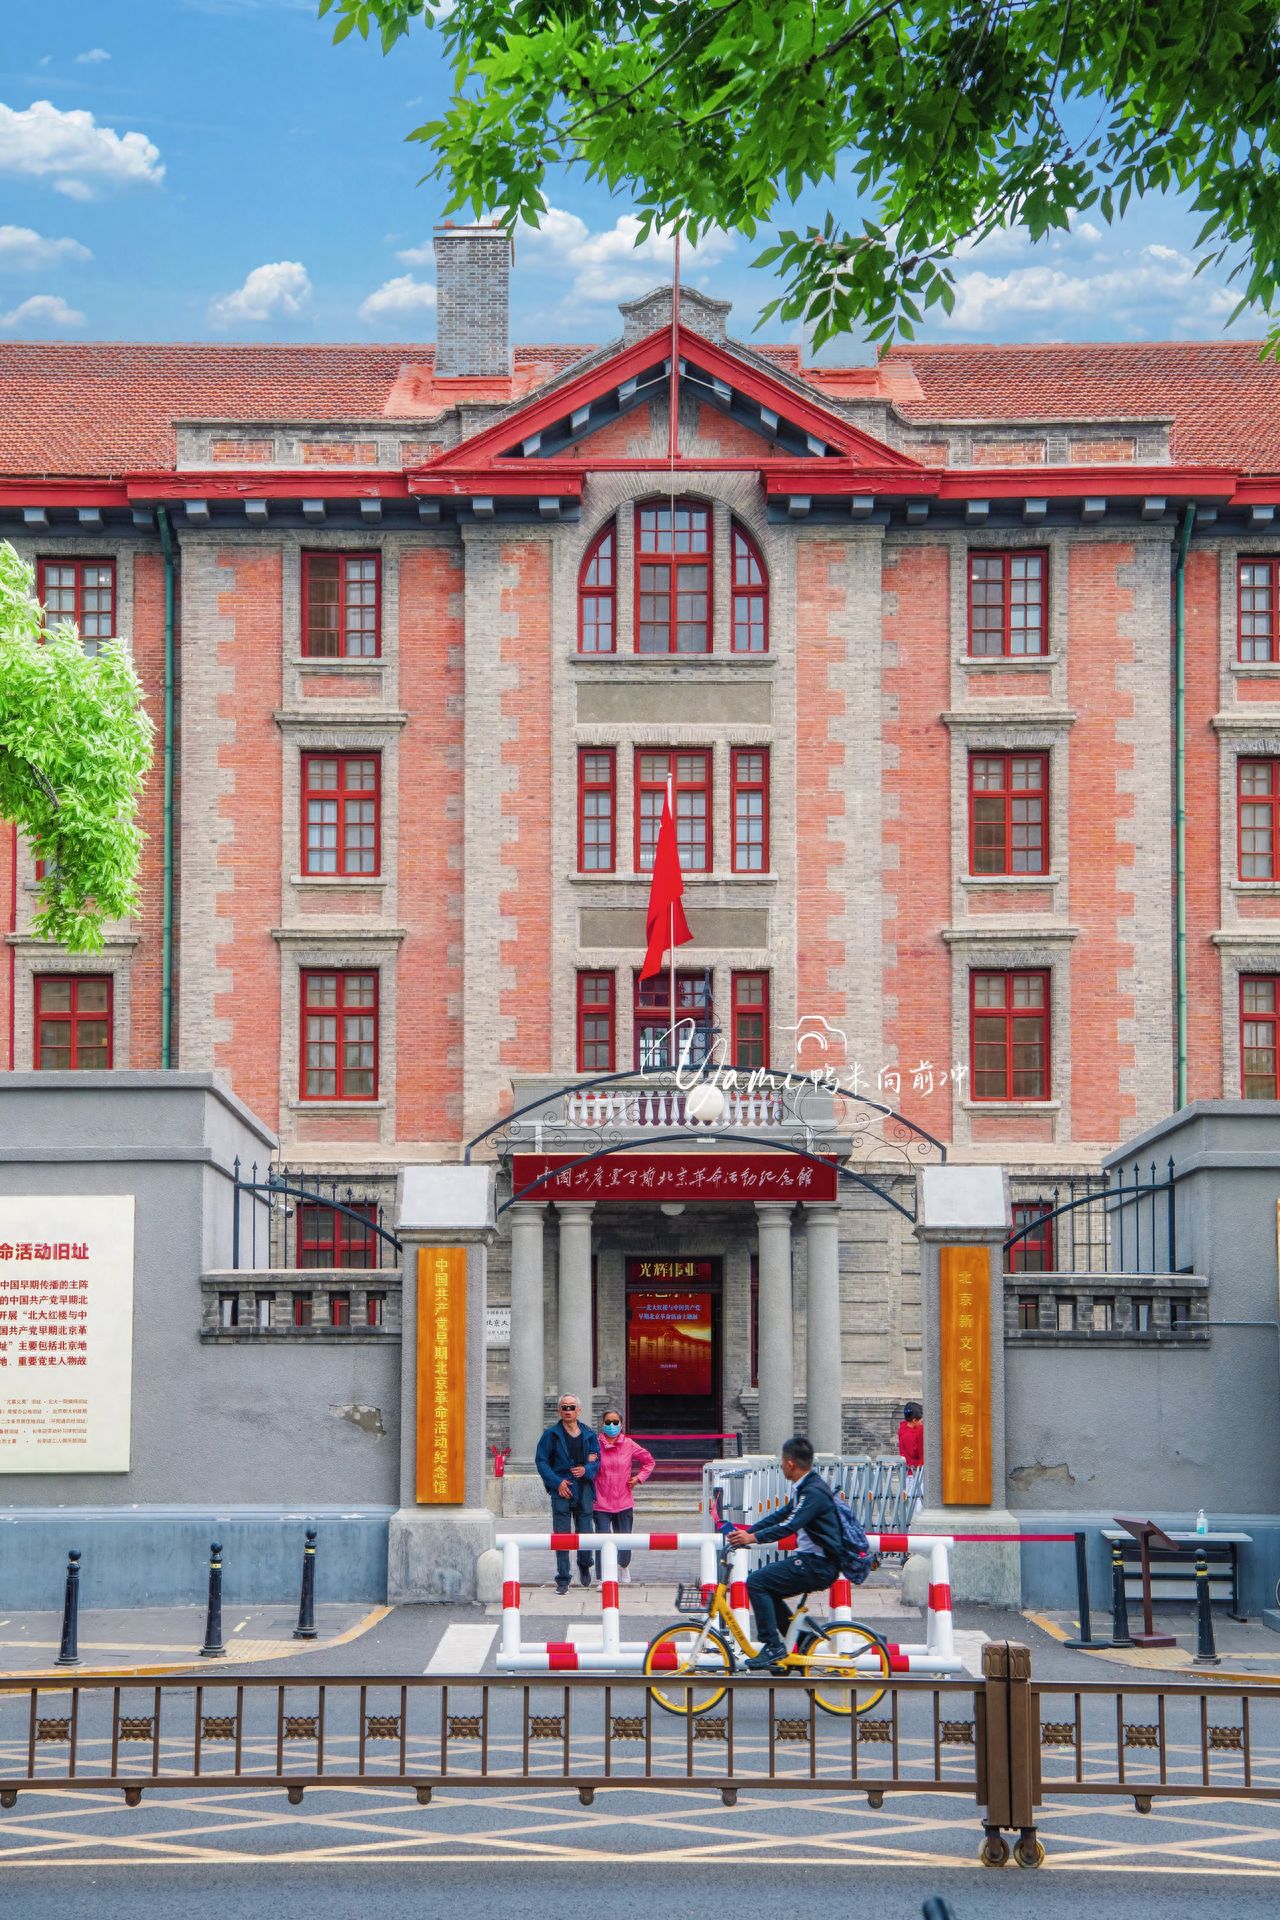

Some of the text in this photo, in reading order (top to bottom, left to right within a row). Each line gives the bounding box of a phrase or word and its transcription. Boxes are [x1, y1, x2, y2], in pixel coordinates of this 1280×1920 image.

[0, 1243, 89, 1260] 命活动旧址
[434, 1258, 449, 1494] 中国共产党早期北京革命活动纪念馆
[959, 1270, 975, 1482] 北京新文化运动纪念馆
